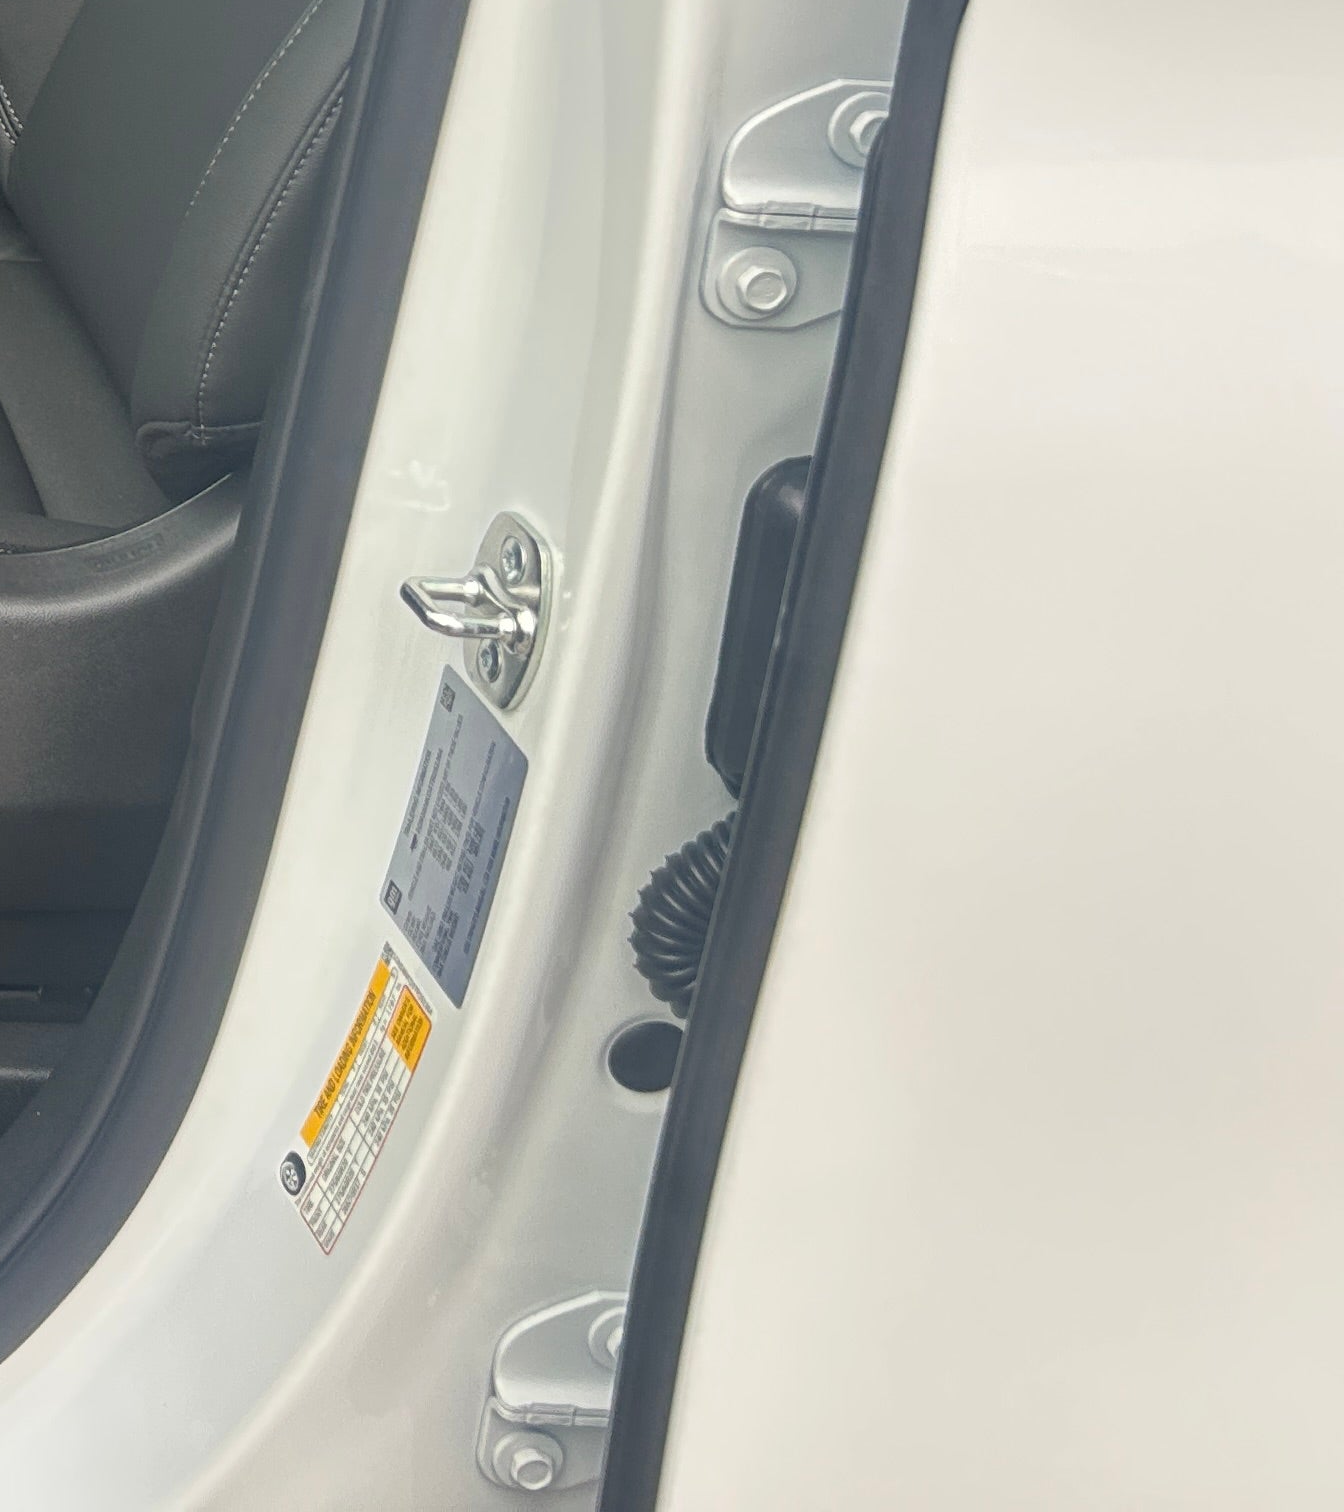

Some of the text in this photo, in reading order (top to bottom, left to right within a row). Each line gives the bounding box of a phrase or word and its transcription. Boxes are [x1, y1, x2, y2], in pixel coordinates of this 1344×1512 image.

[313, 987, 377, 1120] TIRE AND LOADING INFORMATION
